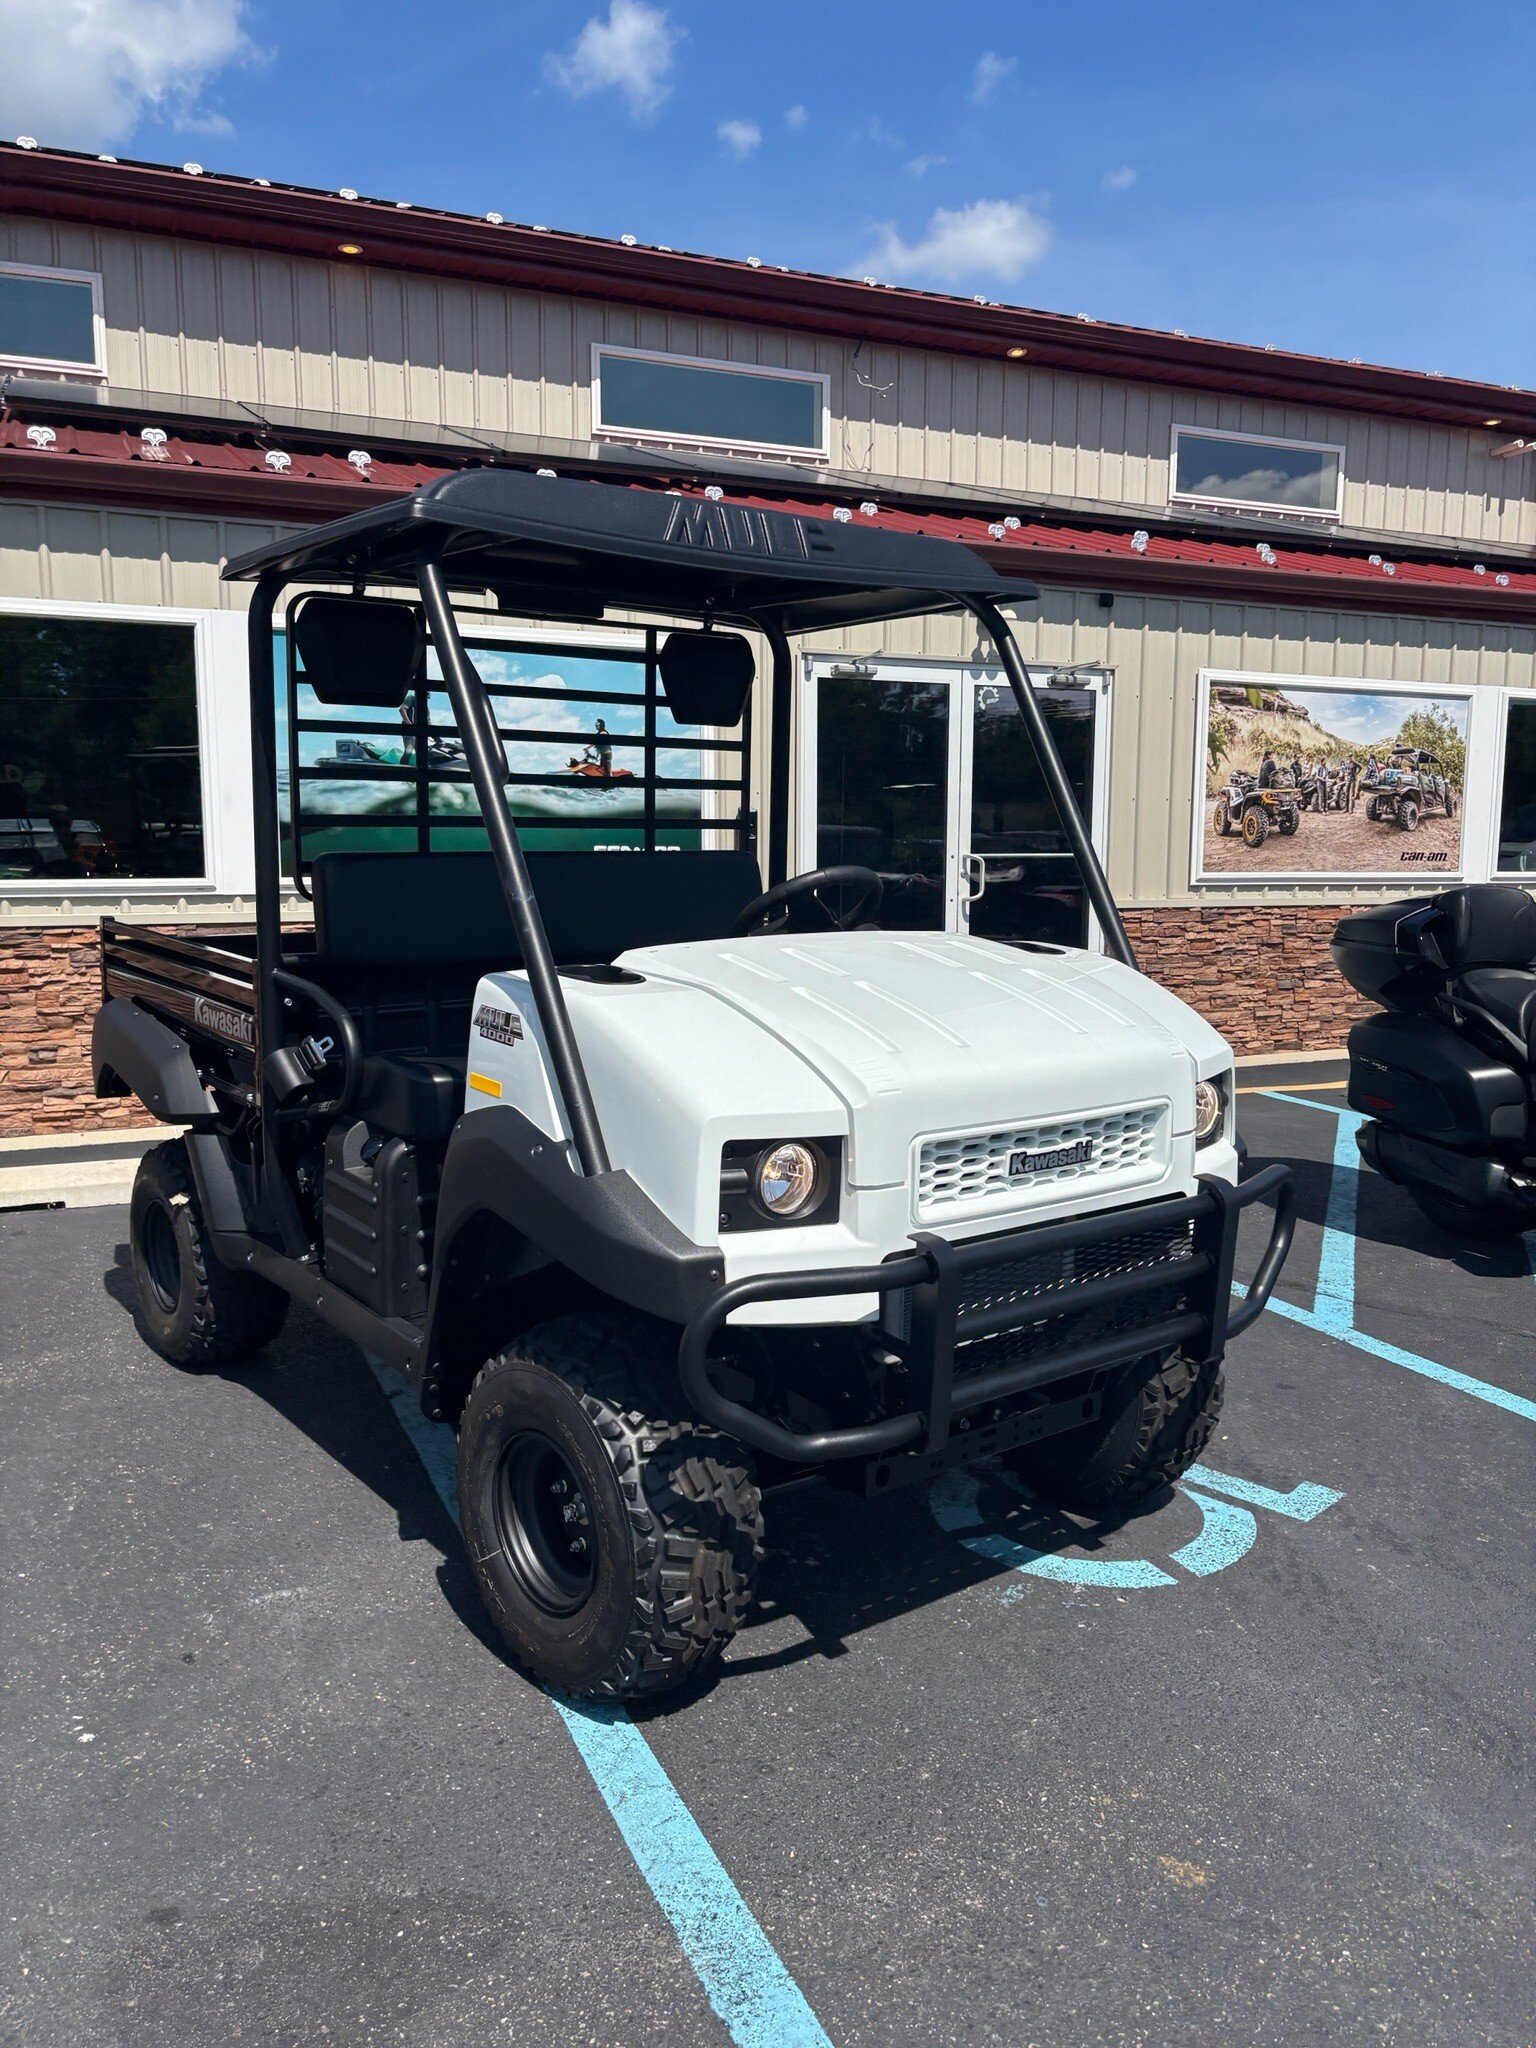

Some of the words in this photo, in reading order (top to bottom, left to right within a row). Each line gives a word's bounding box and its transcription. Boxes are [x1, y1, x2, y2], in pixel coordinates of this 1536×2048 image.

[662, 499, 838, 562] MULE
[194, 996, 254, 1043] Kawasaki
[473, 1004, 524, 1040] MULE
[480, 1026, 515, 1047] 4000
[1009, 1140, 1093, 1176] Kawasaki
